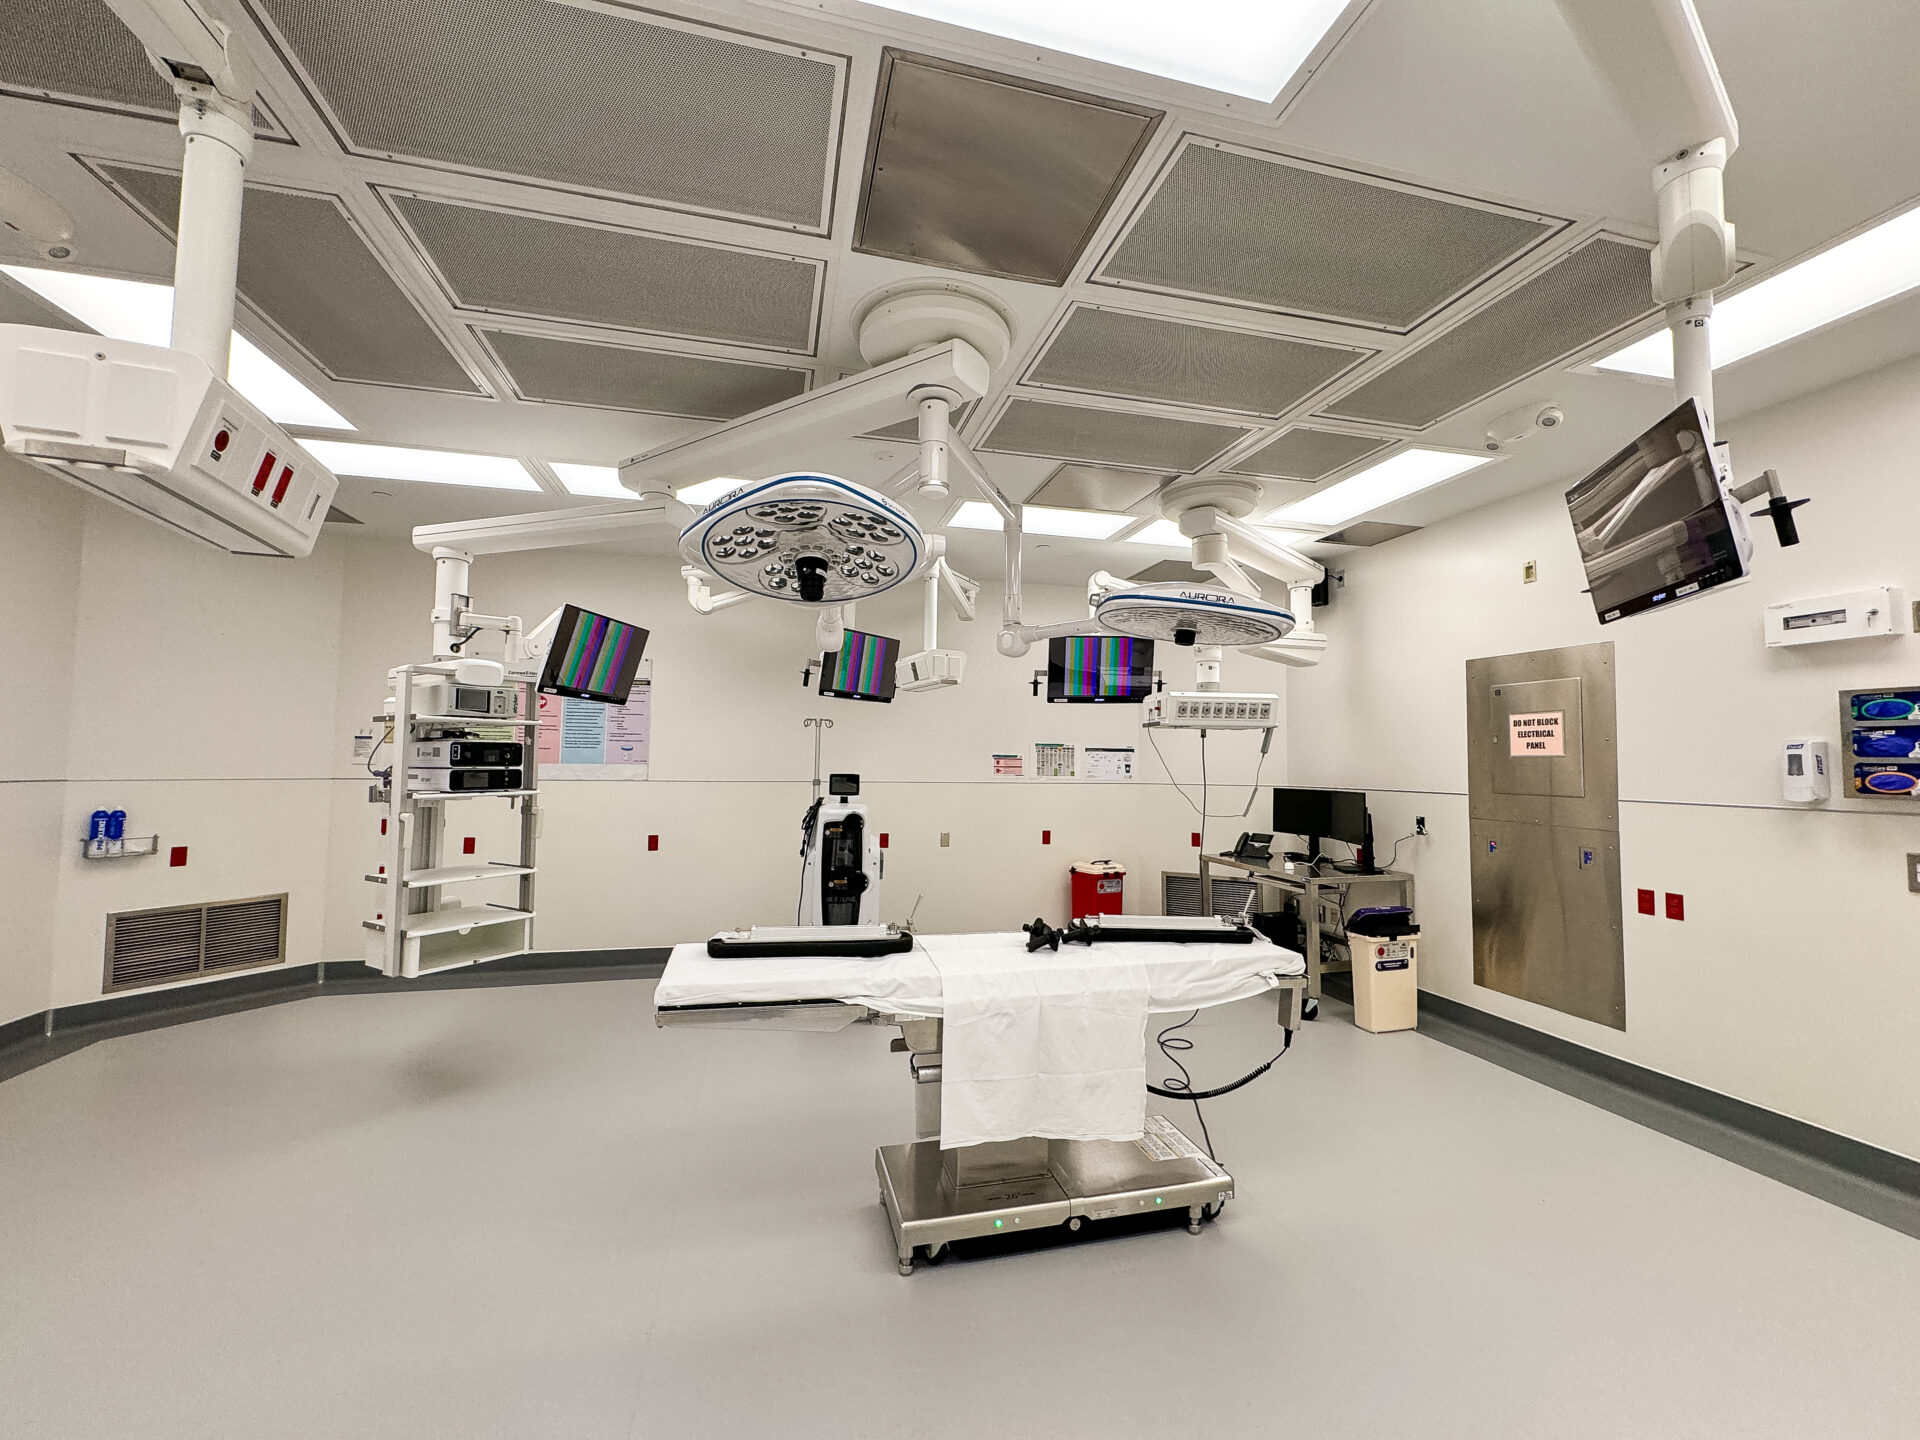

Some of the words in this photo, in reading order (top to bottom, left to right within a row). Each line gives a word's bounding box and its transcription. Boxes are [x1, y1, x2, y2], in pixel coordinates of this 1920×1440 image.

[702, 487, 745, 515] AURORA
[1180, 591, 1235, 604] AURORA
[1513, 719, 1522, 727] DO
[1523, 718, 1536, 727] NOT
[1537, 717, 1559, 726] BLOCK
[1517, 729, 1555, 738] ELECTRICAL
[1526, 741, 1546, 750] PANEL
[96, 820, 106, 850] PRE-KLENZ
